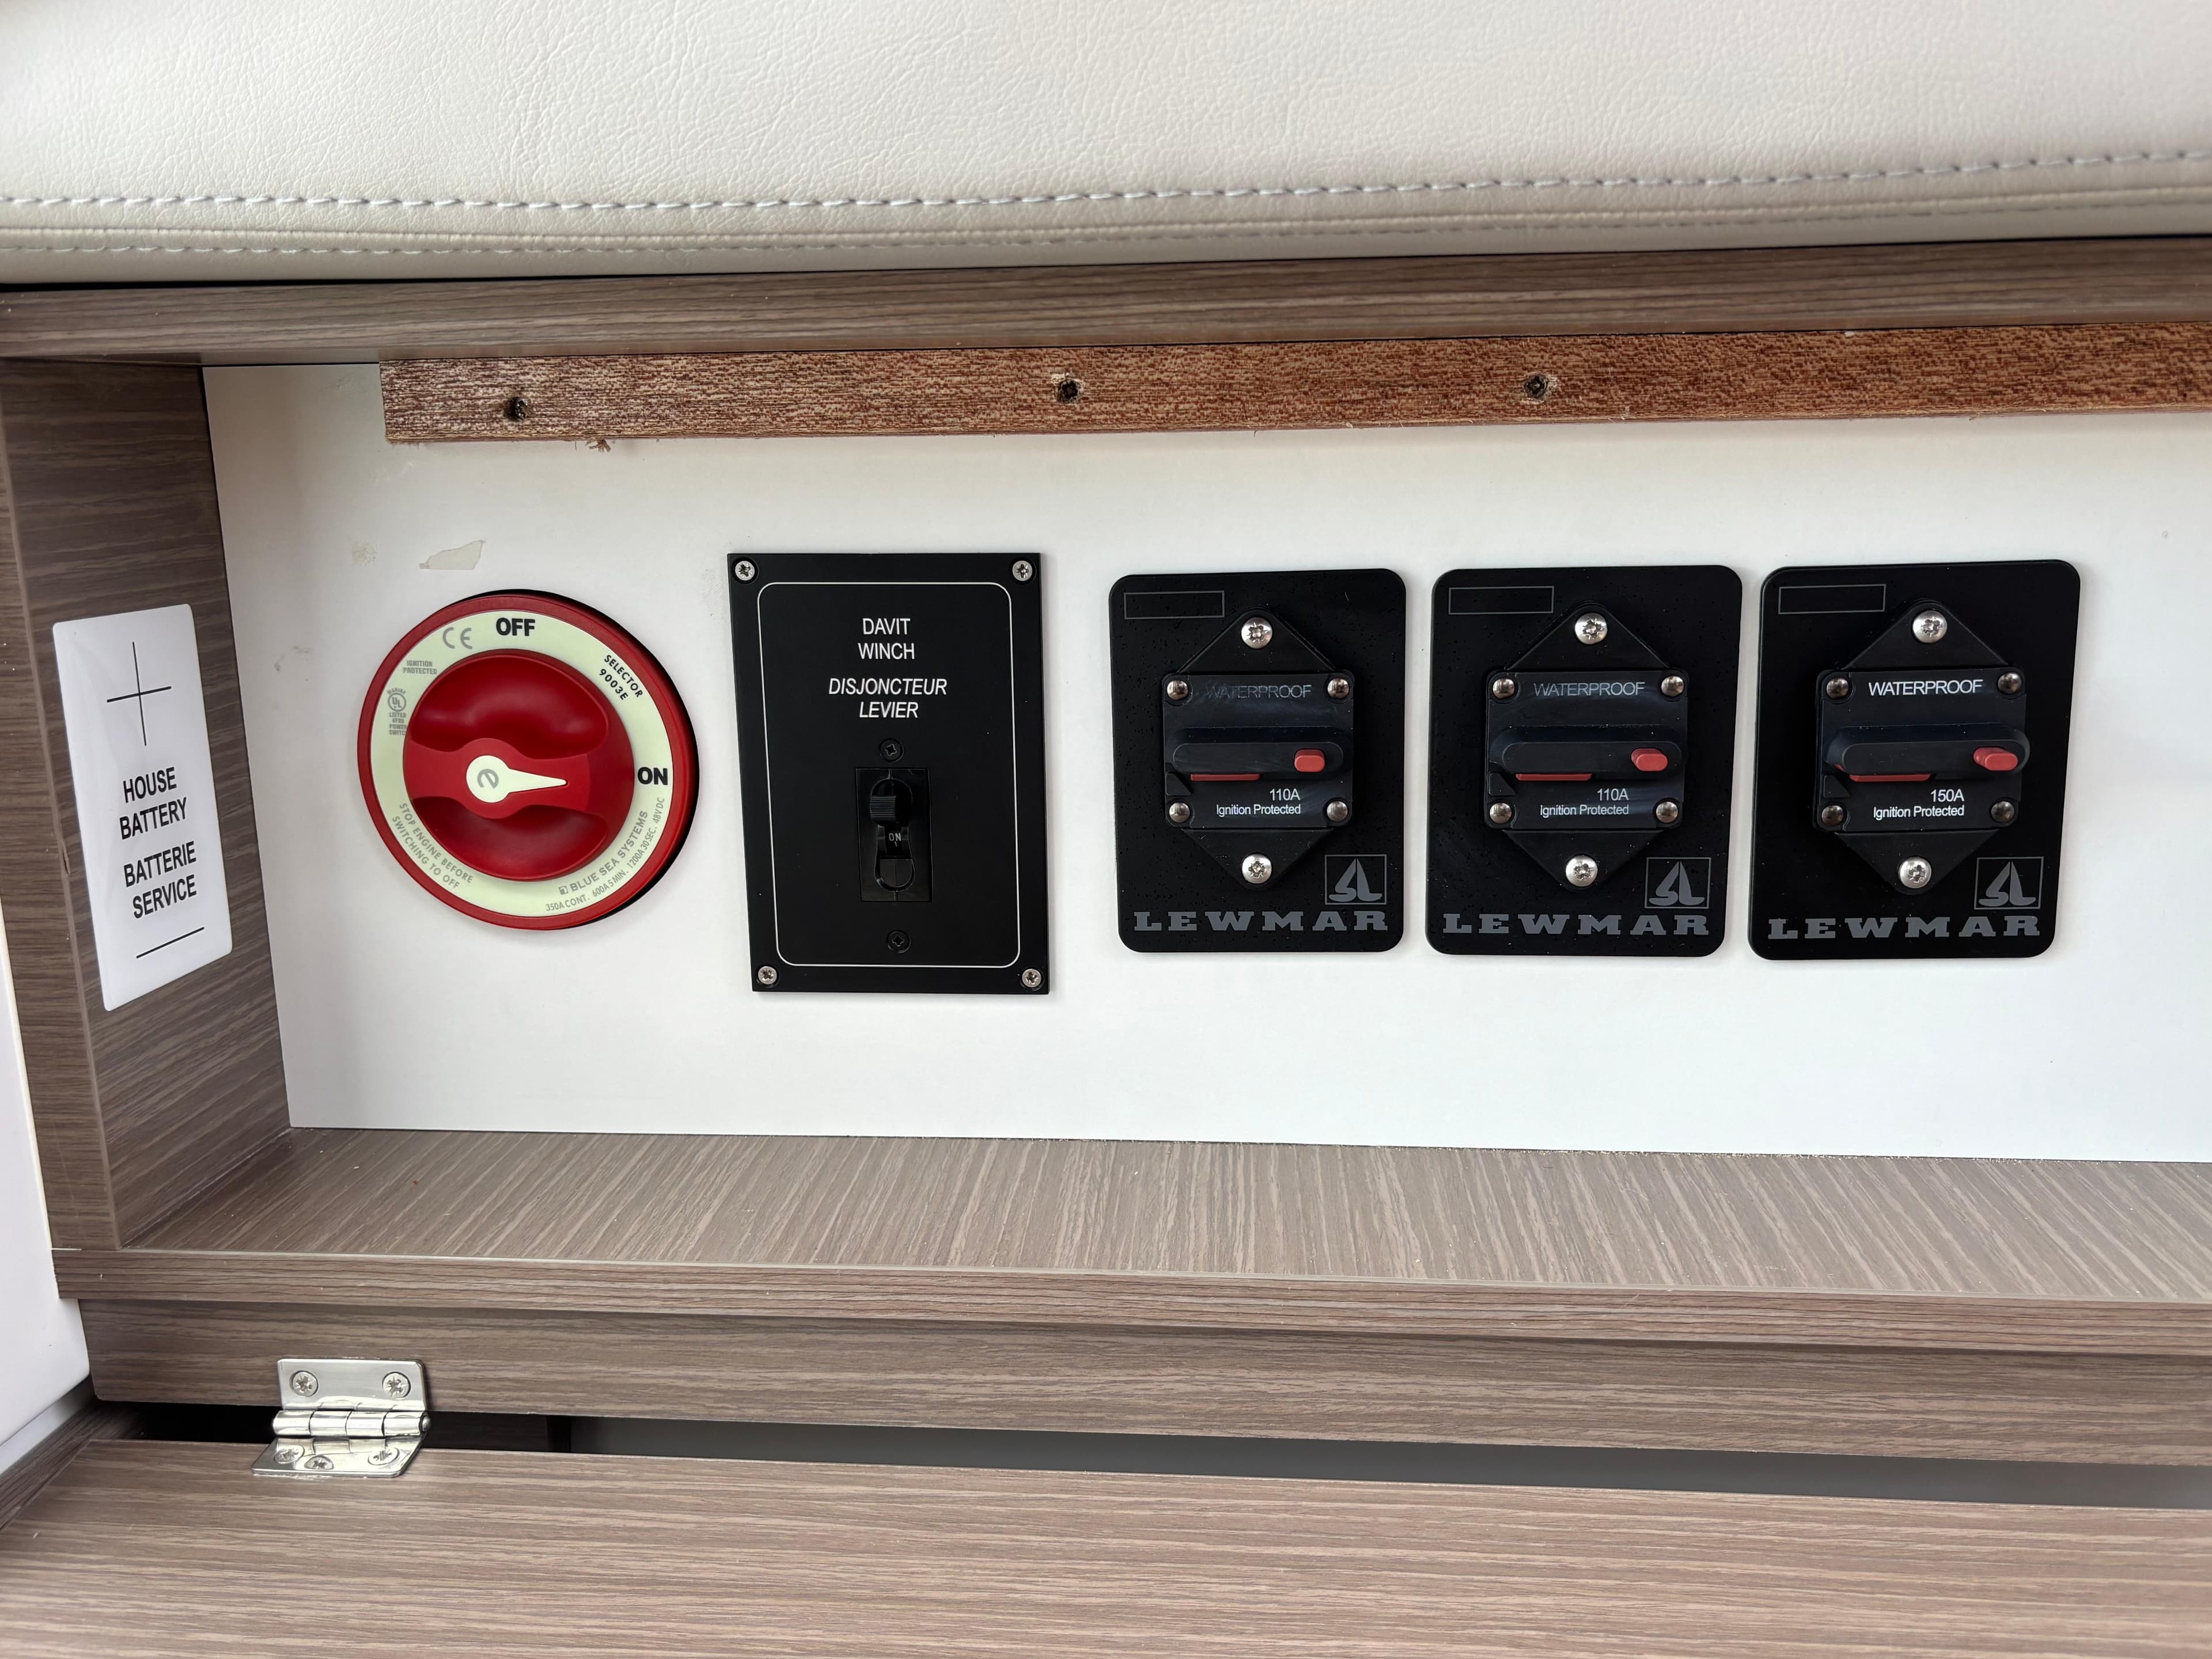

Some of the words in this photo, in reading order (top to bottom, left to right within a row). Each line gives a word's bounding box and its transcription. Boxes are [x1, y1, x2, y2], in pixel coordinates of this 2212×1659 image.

[496, 618, 535, 637] OFF
[862, 618, 911, 635] DAVIT
[858, 642, 915, 660] WINCH
[599, 669, 628, 700] 9003E
[604, 654, 643, 698] SELECTOR
[829, 677, 948, 696] DISJONCTEUR
[1206, 684, 1312, 698] WATERPROOF
[1533, 681, 1645, 696] WATERPROOF
[1868, 679, 1983, 696] WATERPROOF
[859, 701, 919, 718] LEVIER
[123, 766, 177, 803] HOUSE
[637, 767, 668, 785] ON
[1269, 789, 1300, 801] 110A
[1596, 789, 1629, 801] 110A
[1930, 789, 1964, 802] 150A
[119, 797, 188, 840] BATTERY
[1216, 804, 1251, 817] Ignition
[1253, 803, 1301, 815] Protected
[1540, 805, 1577, 818] Ignition
[1578, 804, 1629, 816] Protected
[1873, 806, 1911, 820] Ignition
[1913, 805, 1964, 817] Protected
[400, 803, 415, 825] STOP
[413, 828, 441, 859] ENGINE
[441, 858, 474, 883] BEFORE
[889, 832, 902, 842] ON
[392, 816, 429, 864] SWITCHING
[429, 863, 441, 875] TO
[442, 874, 460, 888] OFF
[570, 872, 599, 892] BLUE
[599, 858, 620, 876] SEA
[618, 810, 647, 858] SYSTEMS
[123, 840, 196, 887] BATTERIE
[592, 882, 611, 897] 600A
[627, 850, 645, 869] 1200A
[132, 874, 198, 919] SERVICE
[1133, 909, 1388, 931] LEWMAR
[1442, 912, 1709, 936] LEWMAR
[1768, 915, 2040, 940] LEWMAR
